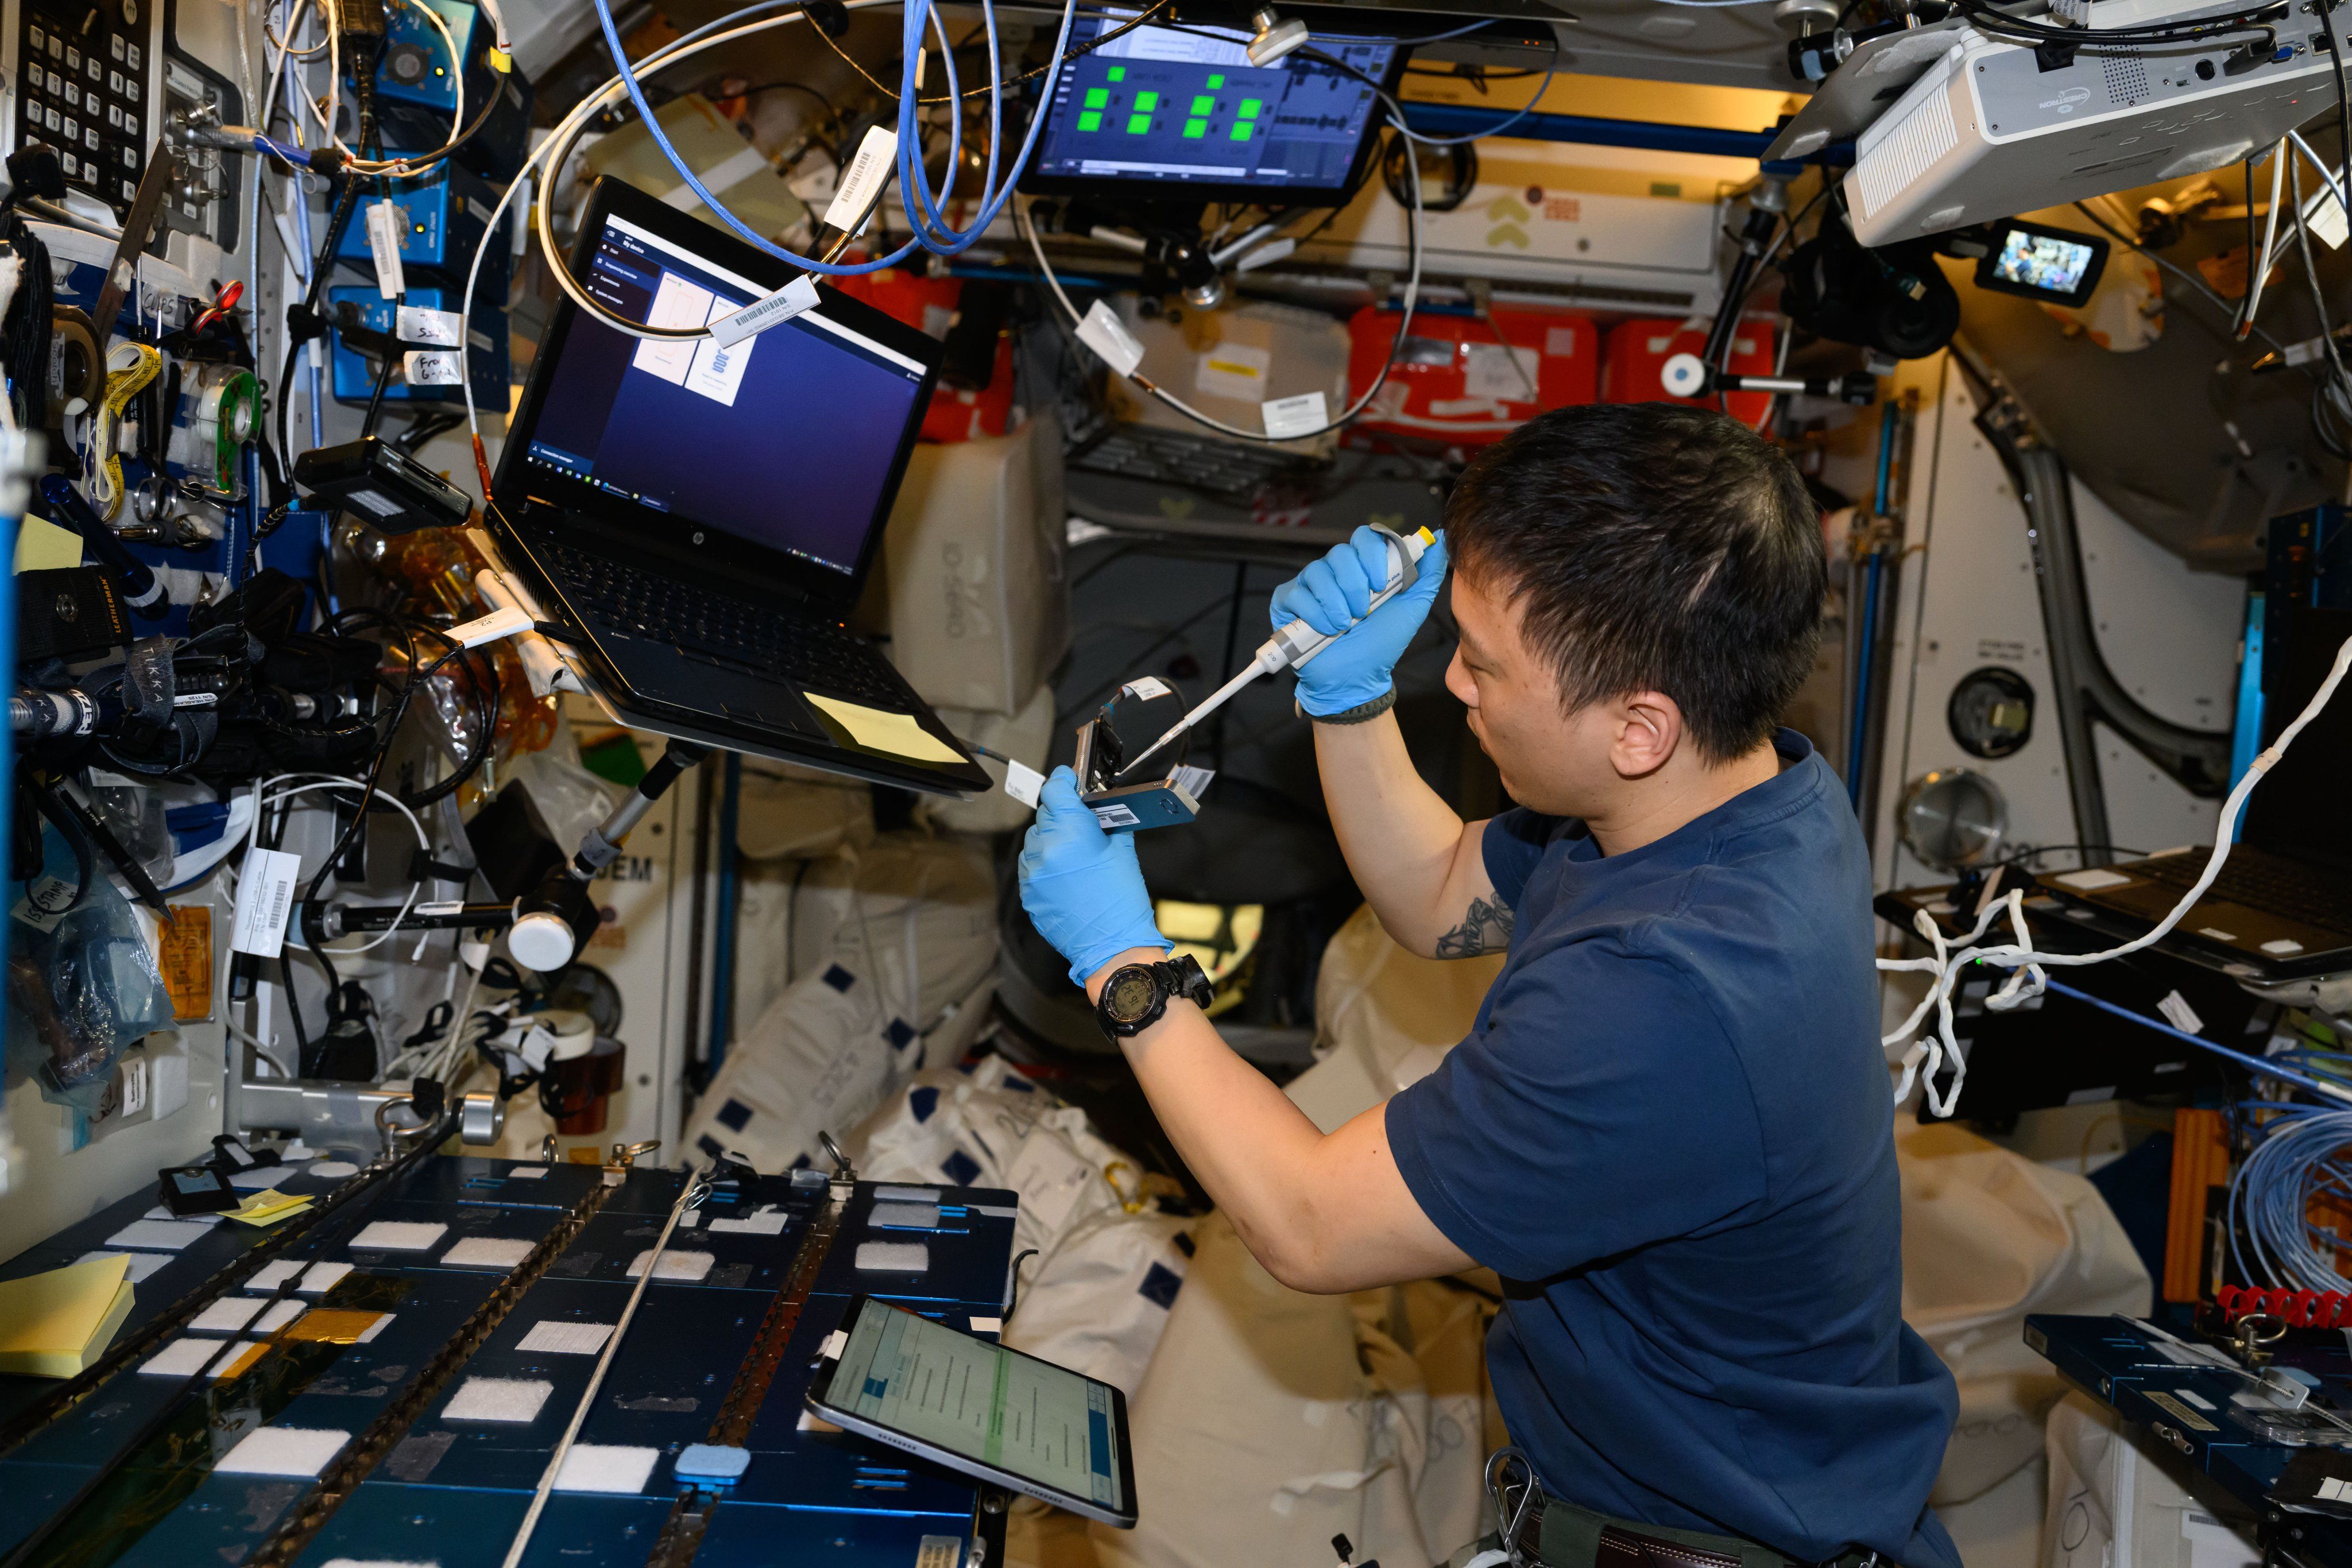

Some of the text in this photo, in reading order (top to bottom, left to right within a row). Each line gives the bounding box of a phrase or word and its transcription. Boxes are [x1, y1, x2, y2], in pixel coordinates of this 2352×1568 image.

[127, 5, 136, 17] PTT
[115, 42, 123, 52] PAGE
[2040, 93, 2090, 109] CRESTRON
[129, 121, 137, 129] MON
[864, 164, 872, 175] 1012
[629, 242, 645, 254] device
[144, 292, 175, 314] CLIPS
[770, 308, 782, 316] 1012
[1390, 572, 1401, 581] plus
[102, 579, 121, 634] LEATHERMAN
[143, 647, 164, 703] TIKKA
[39, 880, 71, 909] STAMP
